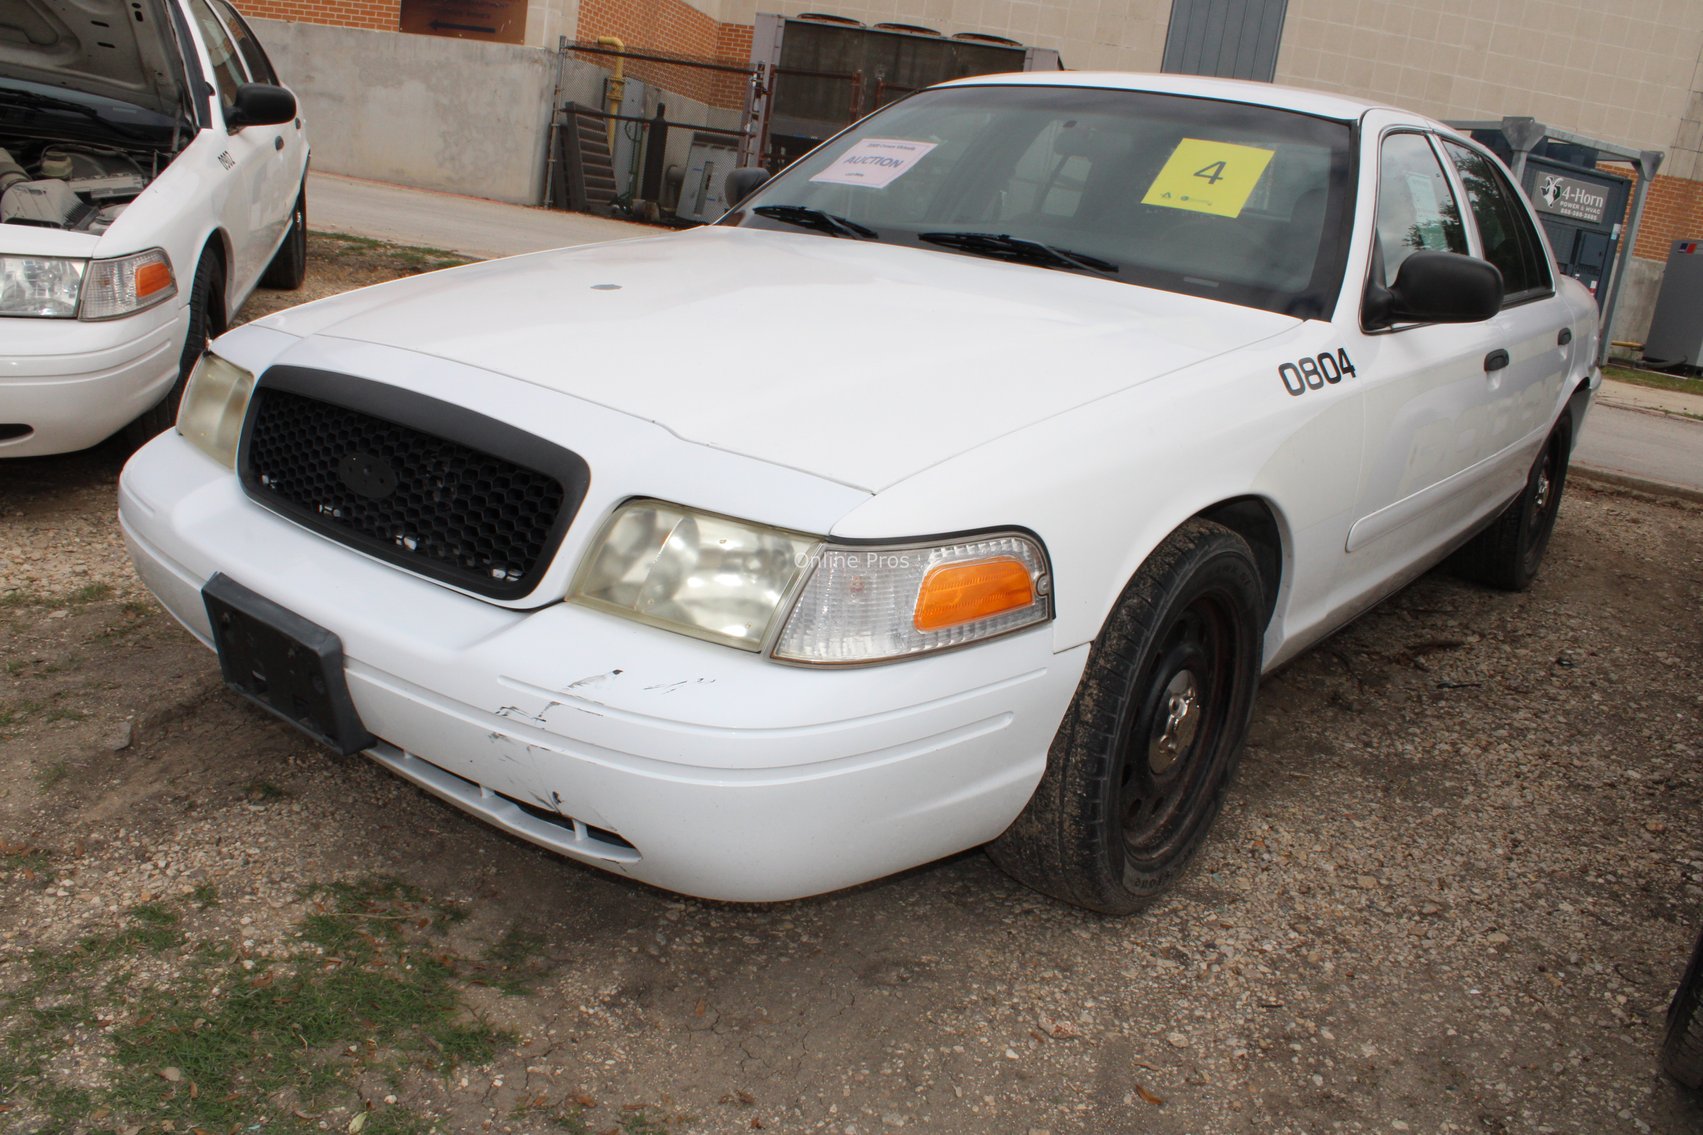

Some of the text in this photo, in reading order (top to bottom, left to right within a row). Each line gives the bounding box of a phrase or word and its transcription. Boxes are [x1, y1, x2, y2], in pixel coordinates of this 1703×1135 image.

[844, 155, 904, 168] AUCTION
[1193, 160, 1227, 185] 4
[1560, 200, 1580, 209] POWER
[1585, 206, 1601, 215] HVAC
[1561, 186, 1604, 208] 4-Horn
[1278, 347, 1356, 396] 0804
